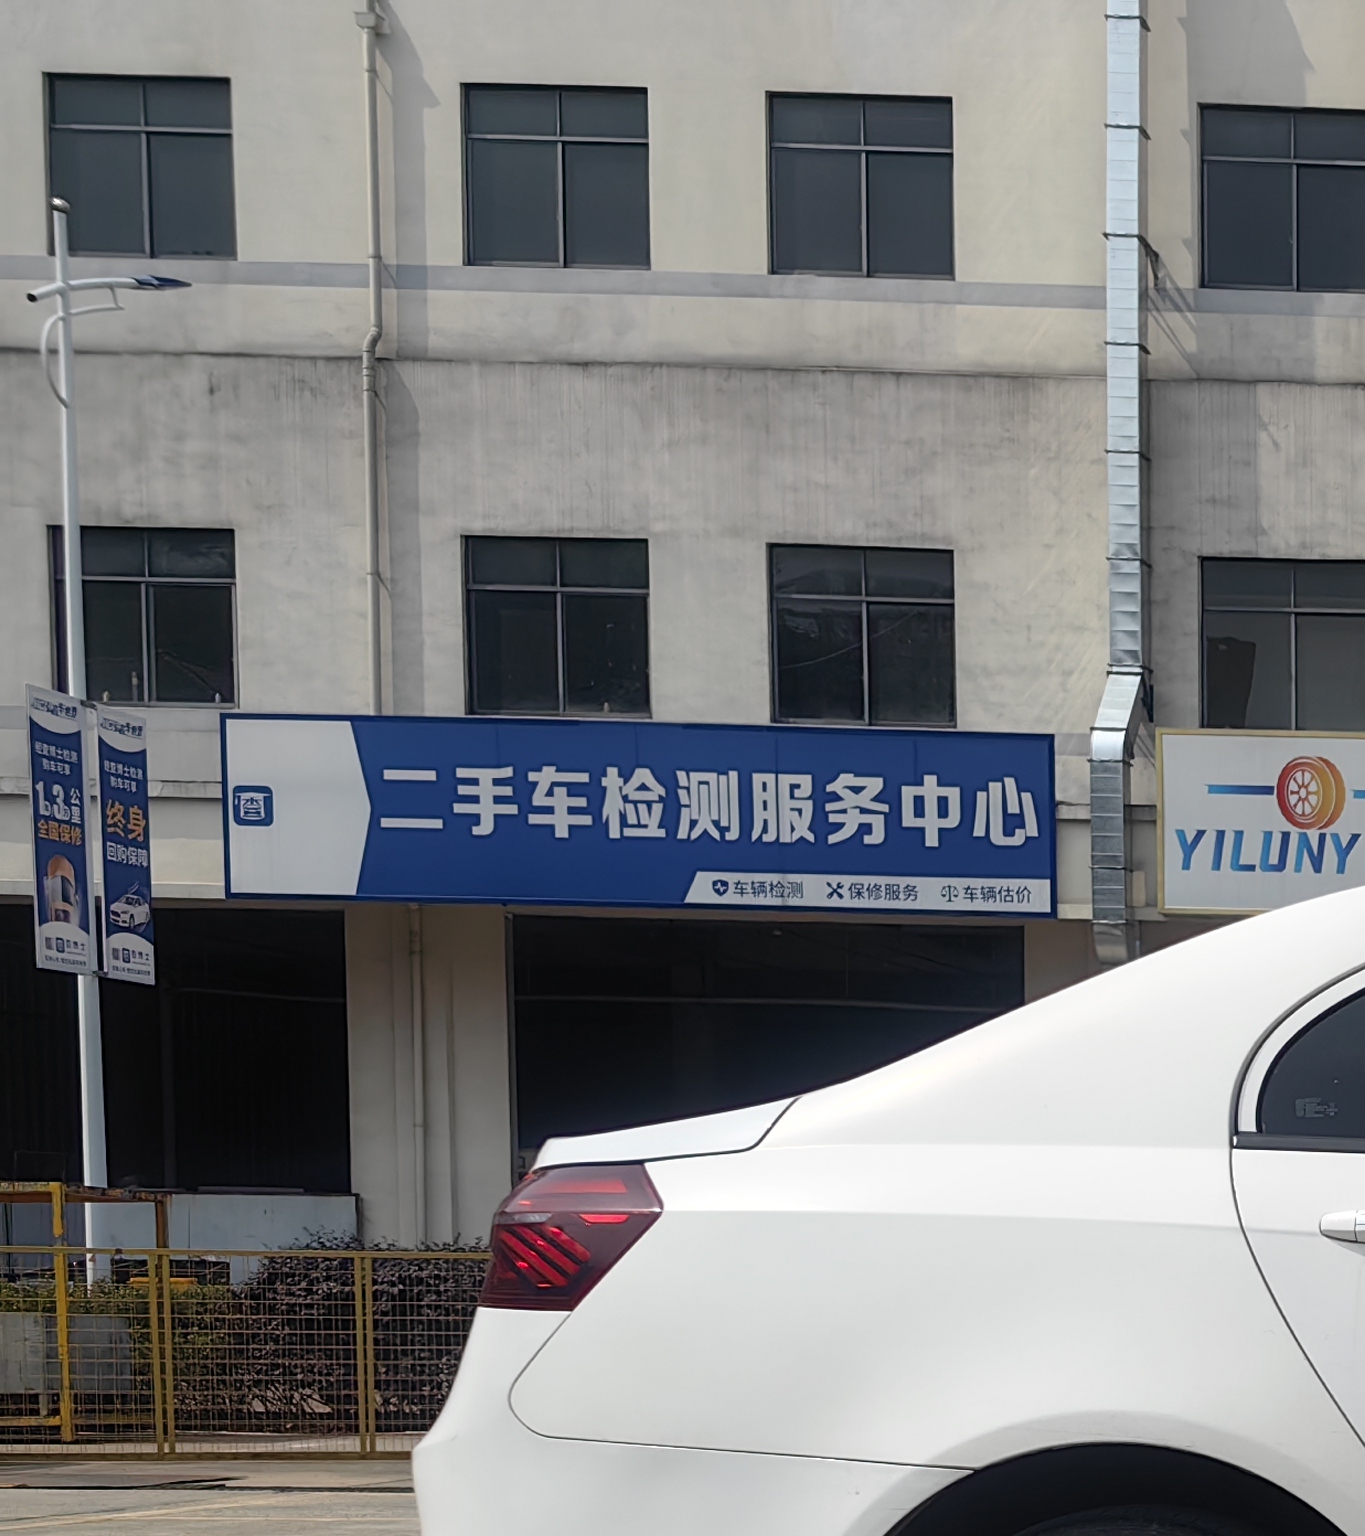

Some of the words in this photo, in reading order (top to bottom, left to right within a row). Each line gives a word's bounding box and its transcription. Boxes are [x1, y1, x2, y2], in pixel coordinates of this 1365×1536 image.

[106, 799, 146, 842] 终身
[379, 765, 1040, 848] 二手车检测服务中心
[732, 880, 804, 900] 车辆检测
[848, 882, 919, 902] 保修服务
[962, 885, 1032, 904] 车辆估价
